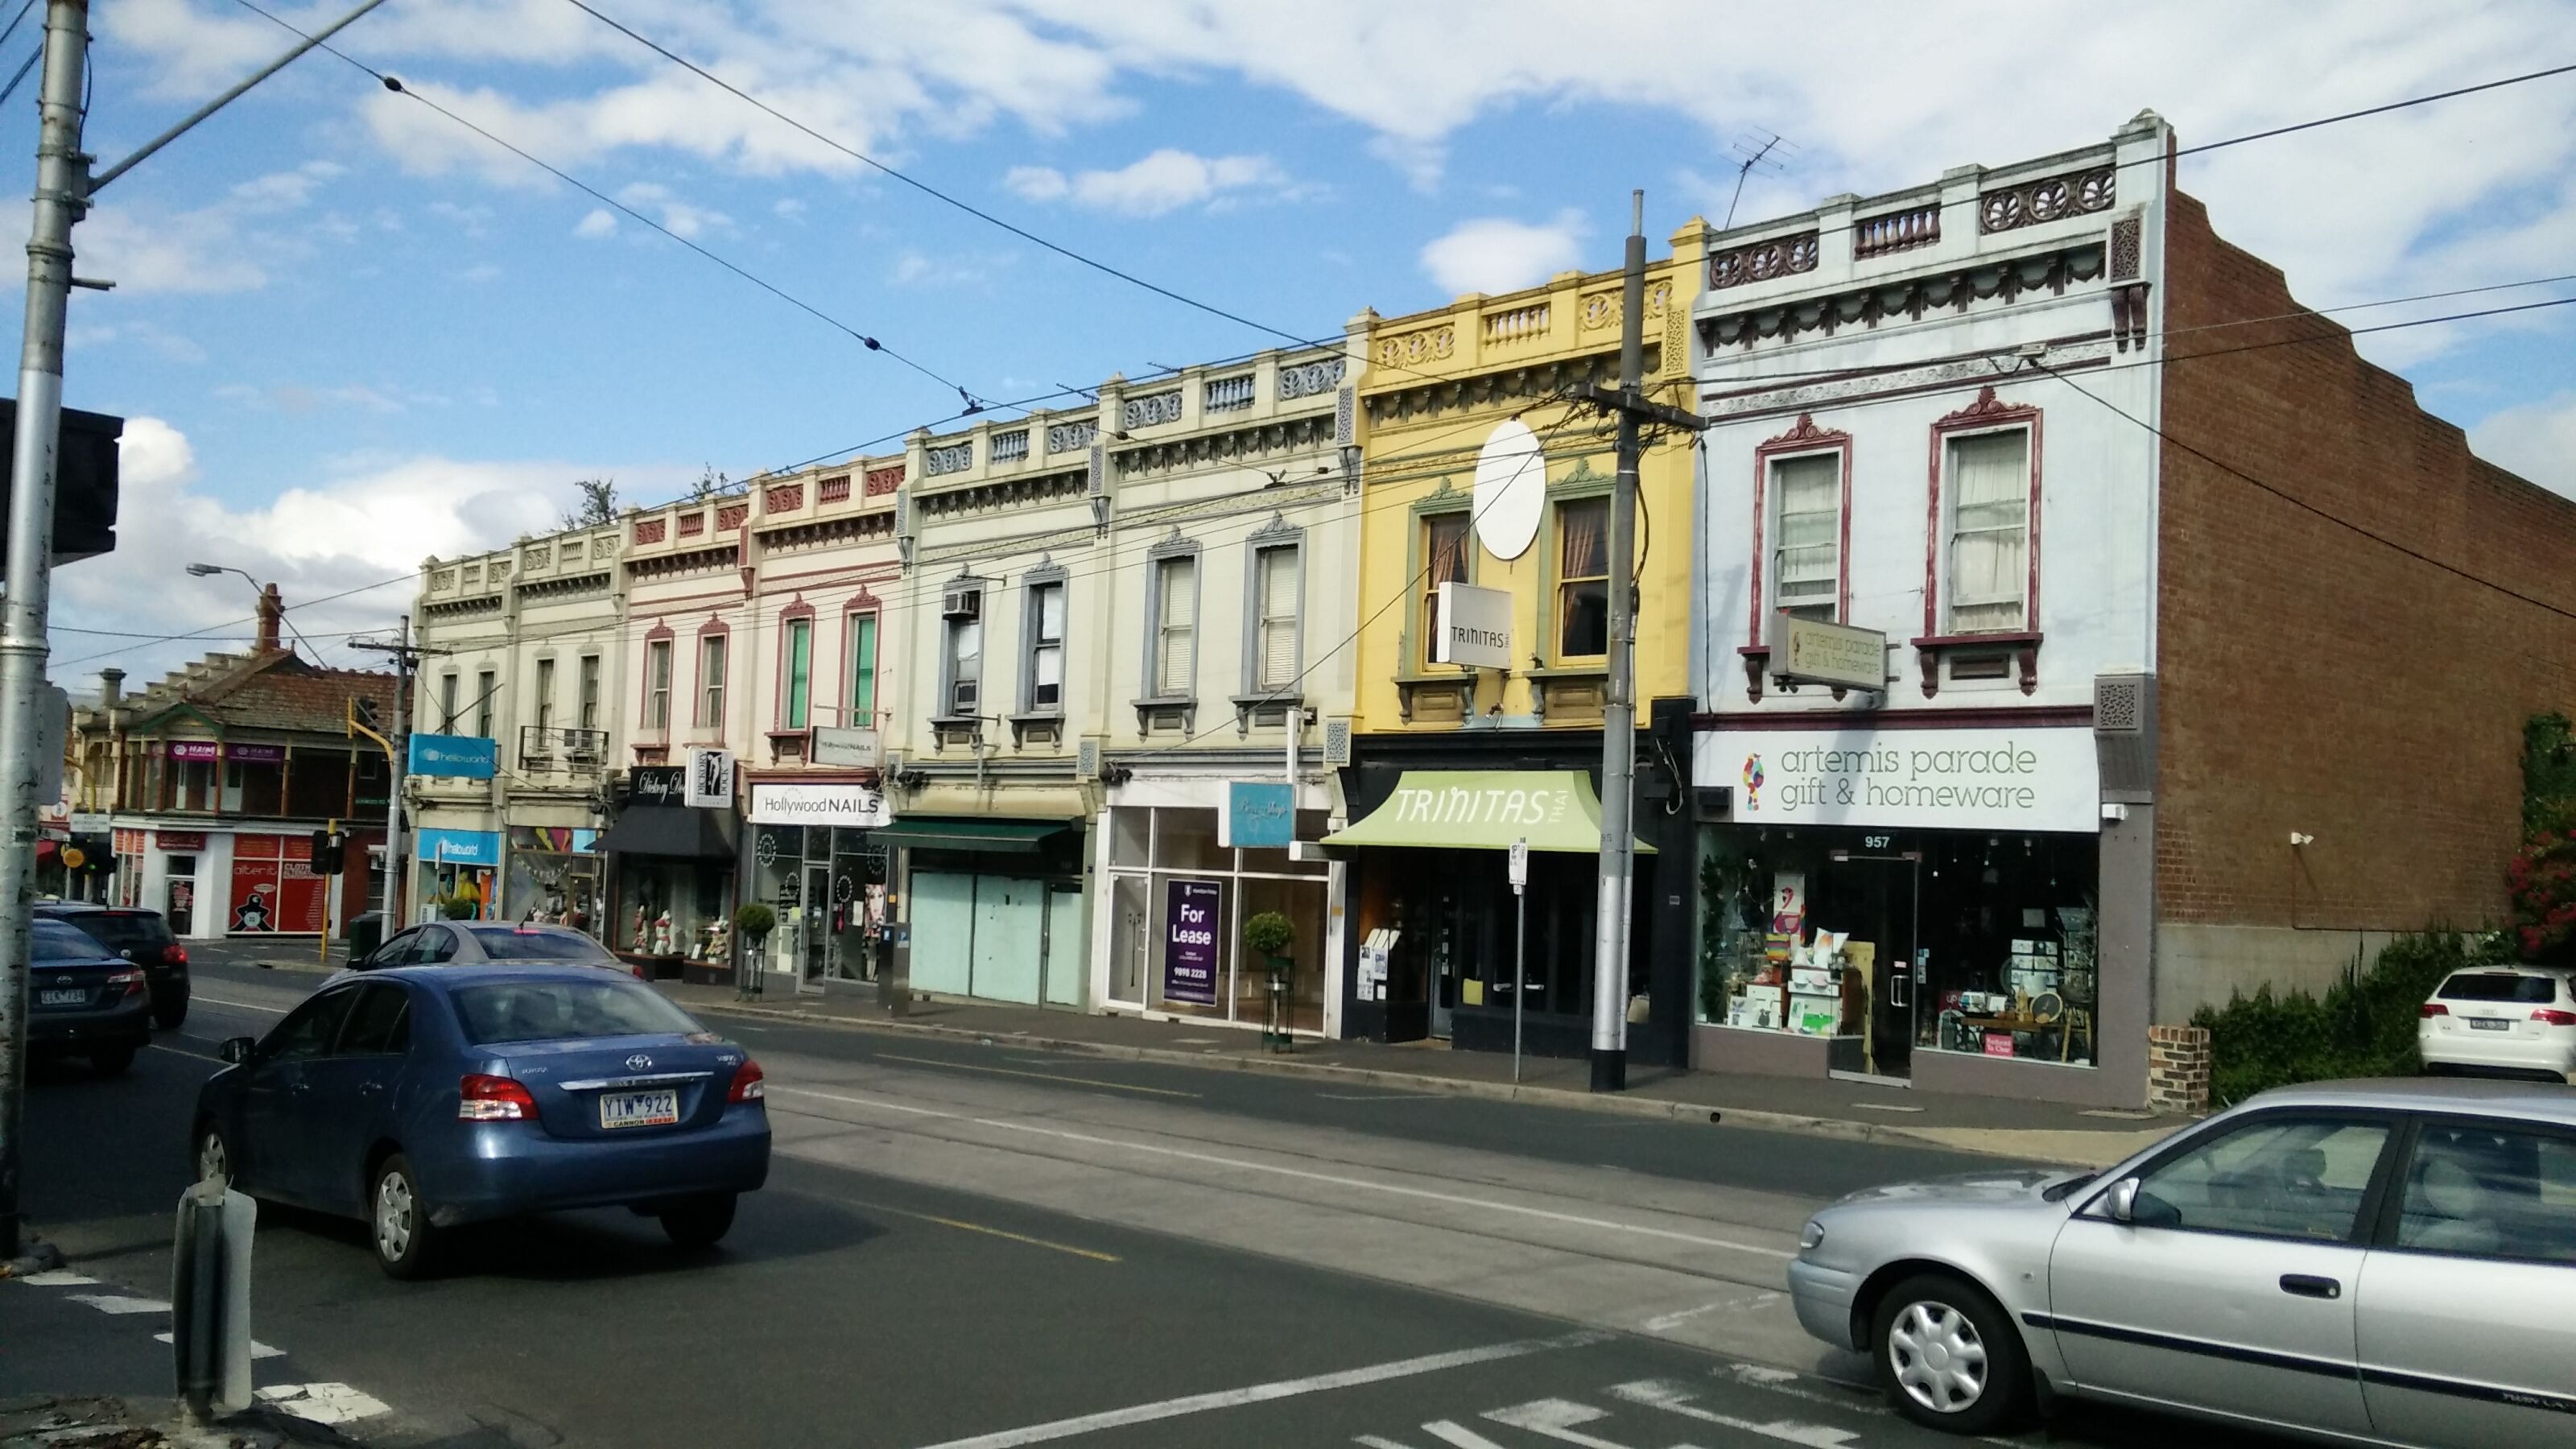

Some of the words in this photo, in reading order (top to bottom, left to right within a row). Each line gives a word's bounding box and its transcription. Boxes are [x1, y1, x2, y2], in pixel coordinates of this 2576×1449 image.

[1451, 626, 1504, 648] TRINITAS
[1805, 632, 1843, 650] artemis
[1845, 638, 1880, 657] parade
[1805, 650, 1820, 669] gift
[1831, 651, 1880, 675] homeware
[1781, 742, 1899, 774] artemis
[1910, 741, 2037, 781] parade
[697, 753, 707, 795] DICKORY
[720, 768, 729, 796] DOCK
[1396, 786, 1550, 824] TRINITAS
[1548, 791, 1569, 823] THAI
[1781, 777, 1827, 811] gift
[1836, 778, 1855, 806] &
[1866, 778, 2035, 808] homeware
[1864, 836, 1890, 848] 957
[1180, 903, 1205, 923] For
[1172, 924, 1212, 945] Lease
[605, 1097, 634, 1117] YIW
[645, 1095, 671, 1113] 922
